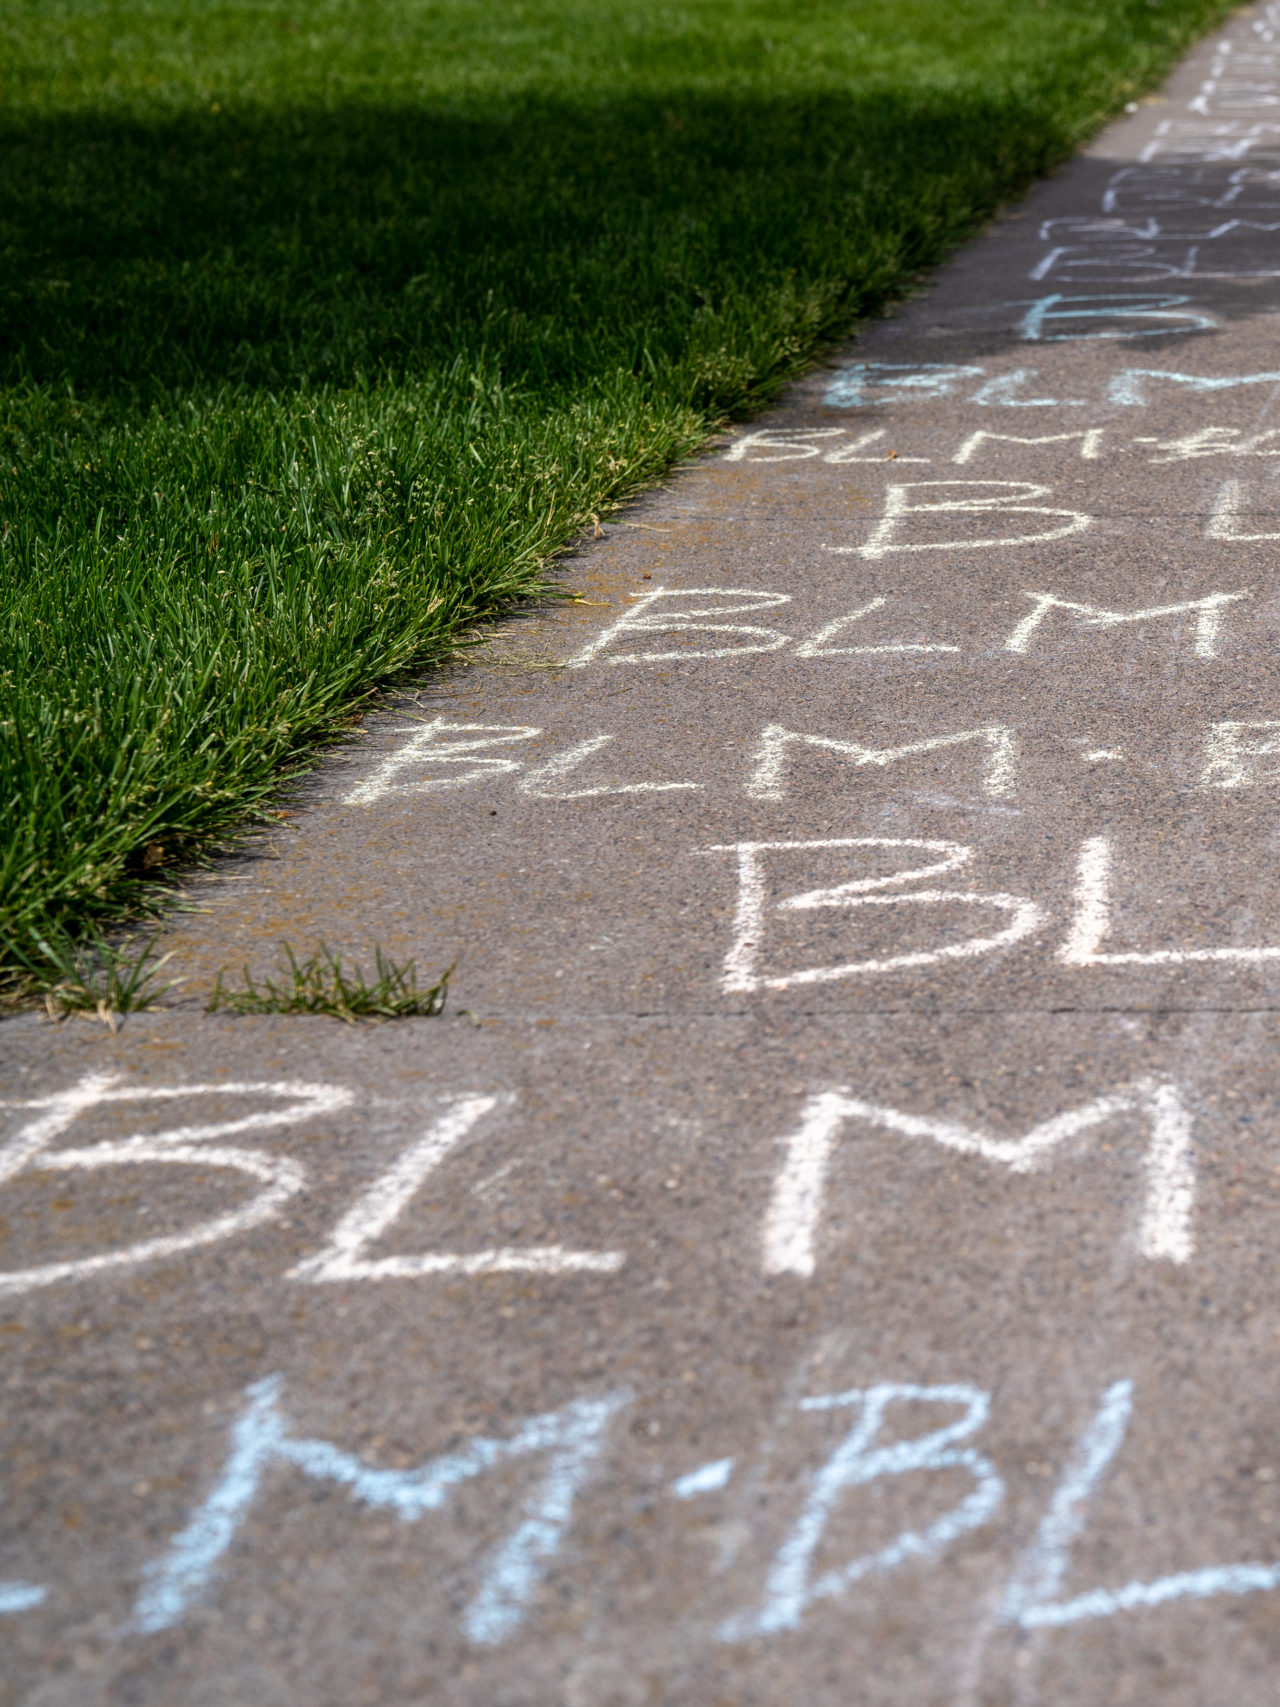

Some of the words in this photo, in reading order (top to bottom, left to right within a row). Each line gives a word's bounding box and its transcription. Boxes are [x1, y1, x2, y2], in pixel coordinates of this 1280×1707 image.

[721, 426, 1104, 466] BLM
[560, 584, 1252, 669] BLM
[340, 715, 1019, 806] BLM
[0, 1070, 1197, 1296] BLM
